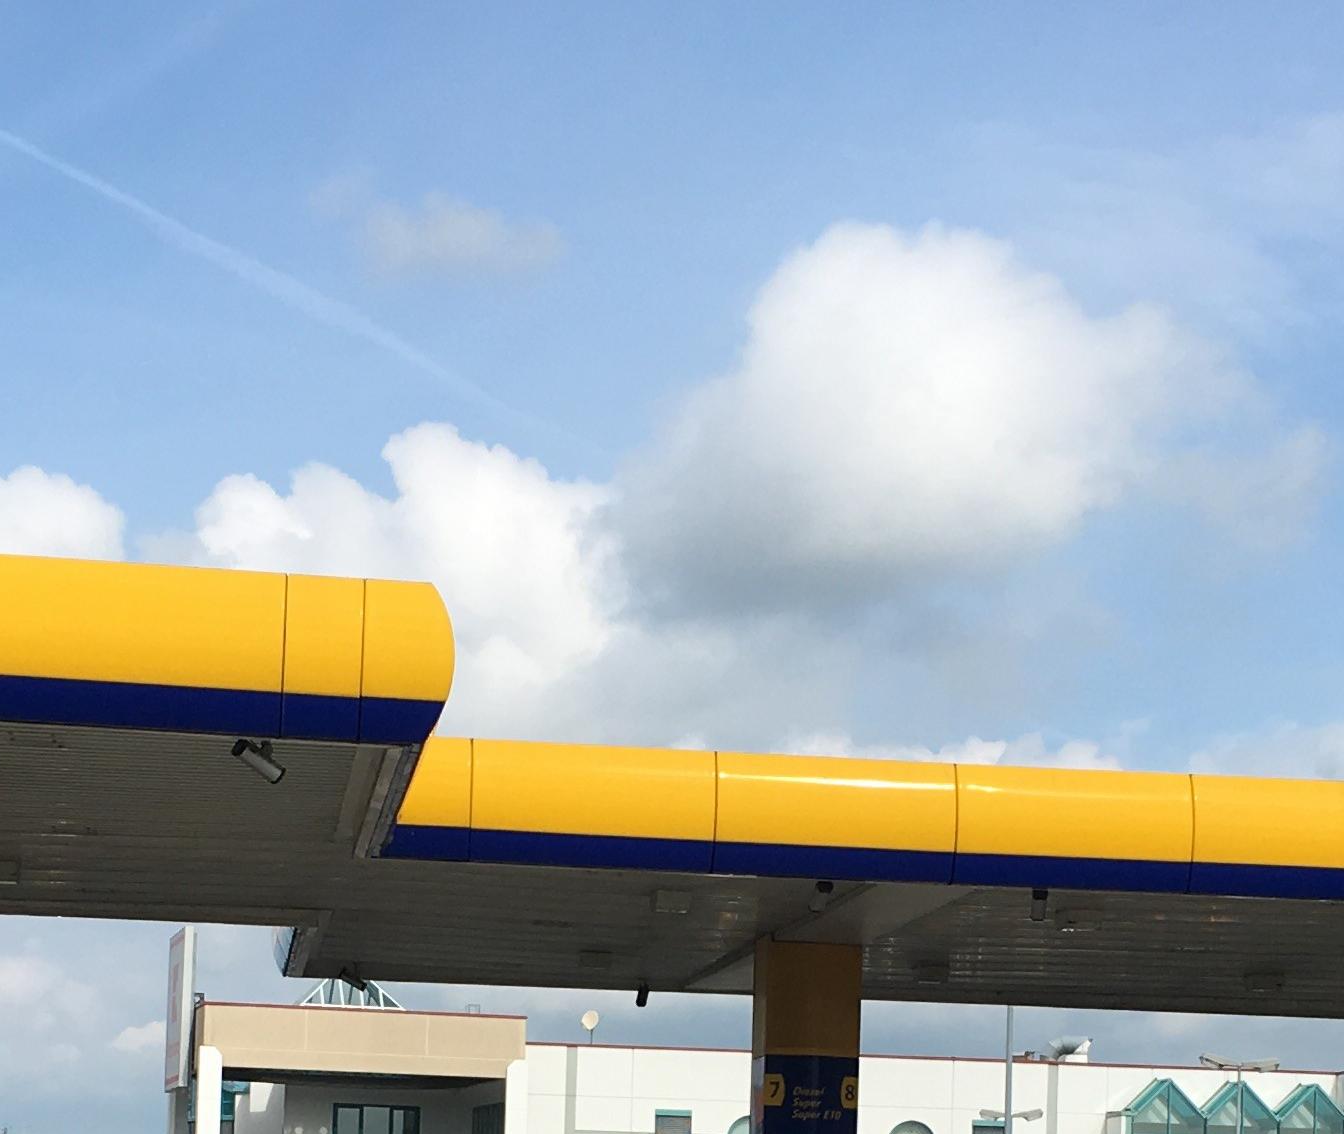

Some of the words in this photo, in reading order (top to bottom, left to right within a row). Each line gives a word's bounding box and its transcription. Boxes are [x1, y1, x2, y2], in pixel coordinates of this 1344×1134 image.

[769, 1081, 780, 1098] 7
[845, 1084, 855, 1101] 8
[792, 1098, 822, 1110] Super
[792, 1110, 821, 1121] Super
